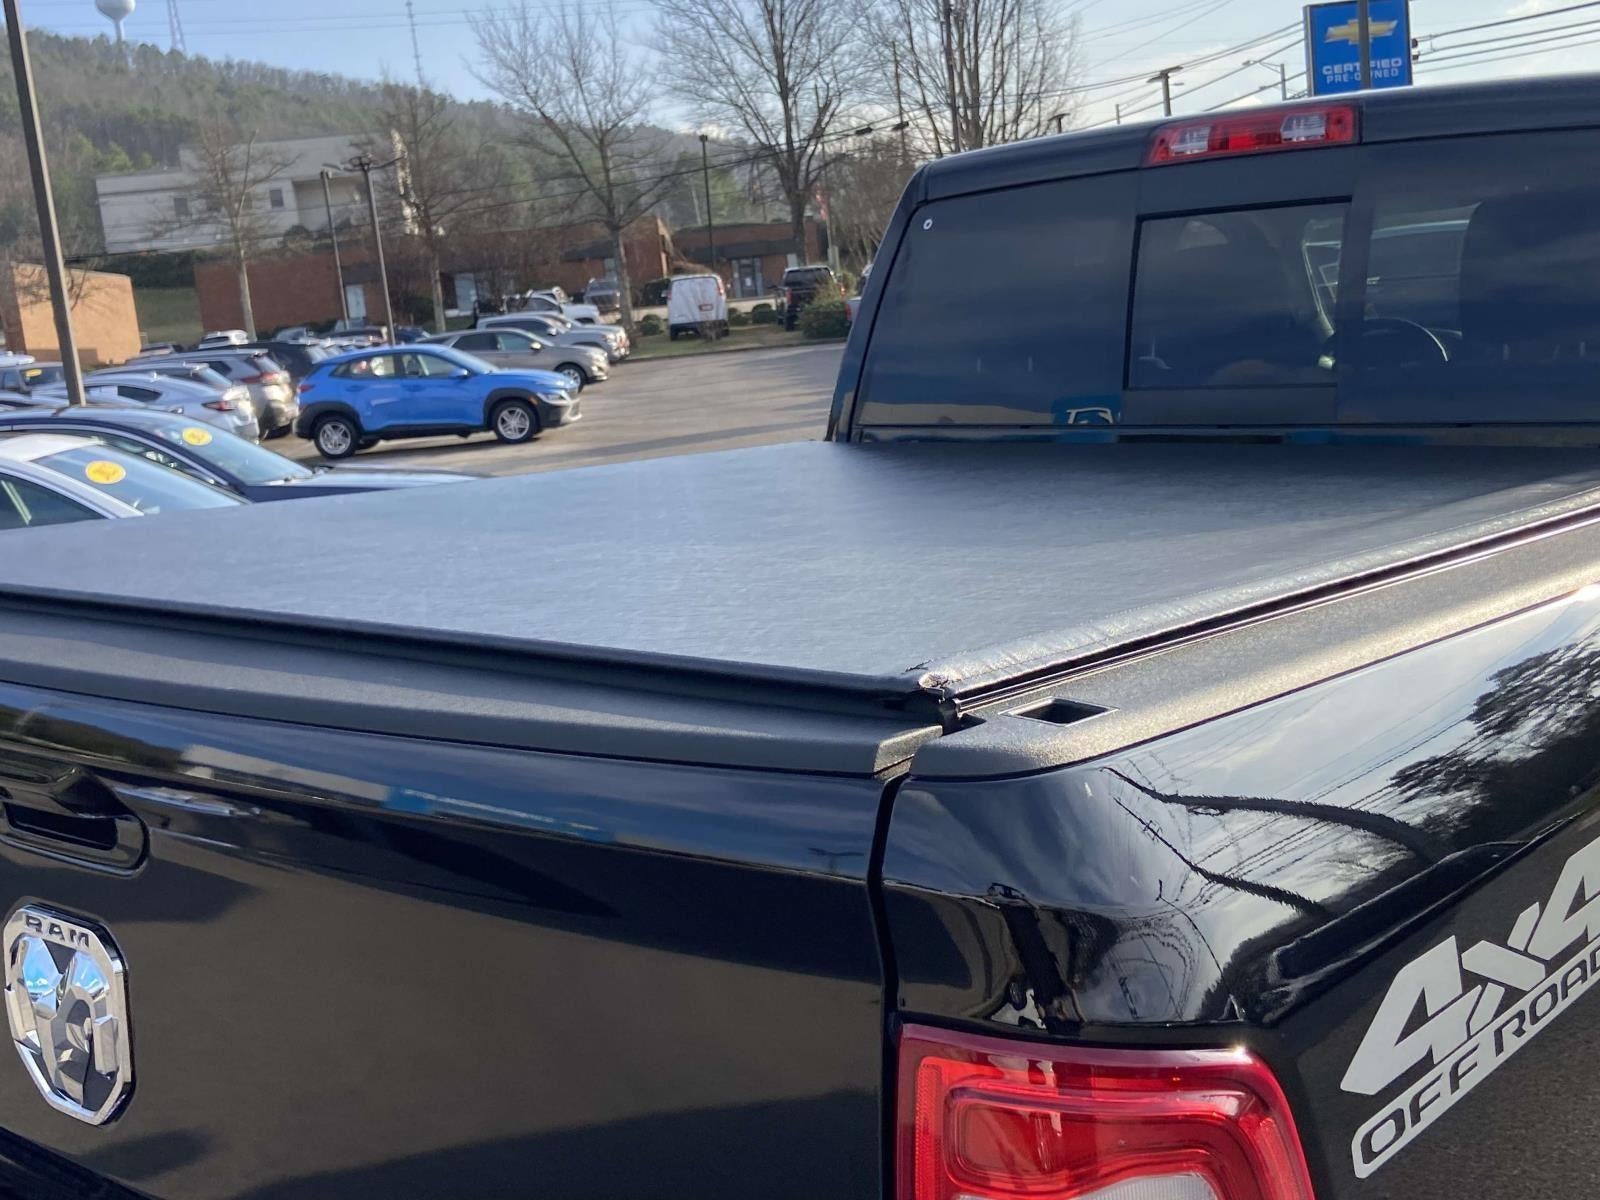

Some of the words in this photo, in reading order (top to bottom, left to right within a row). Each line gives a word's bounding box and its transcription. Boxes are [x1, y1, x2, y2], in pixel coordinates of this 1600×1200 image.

[1322, 58, 1402, 76] CERTFIED
[1326, 67, 1399, 85] PRE-ONED
[25, 914, 90, 948] RAM
[1360, 1043, 1481, 1165] OFF
